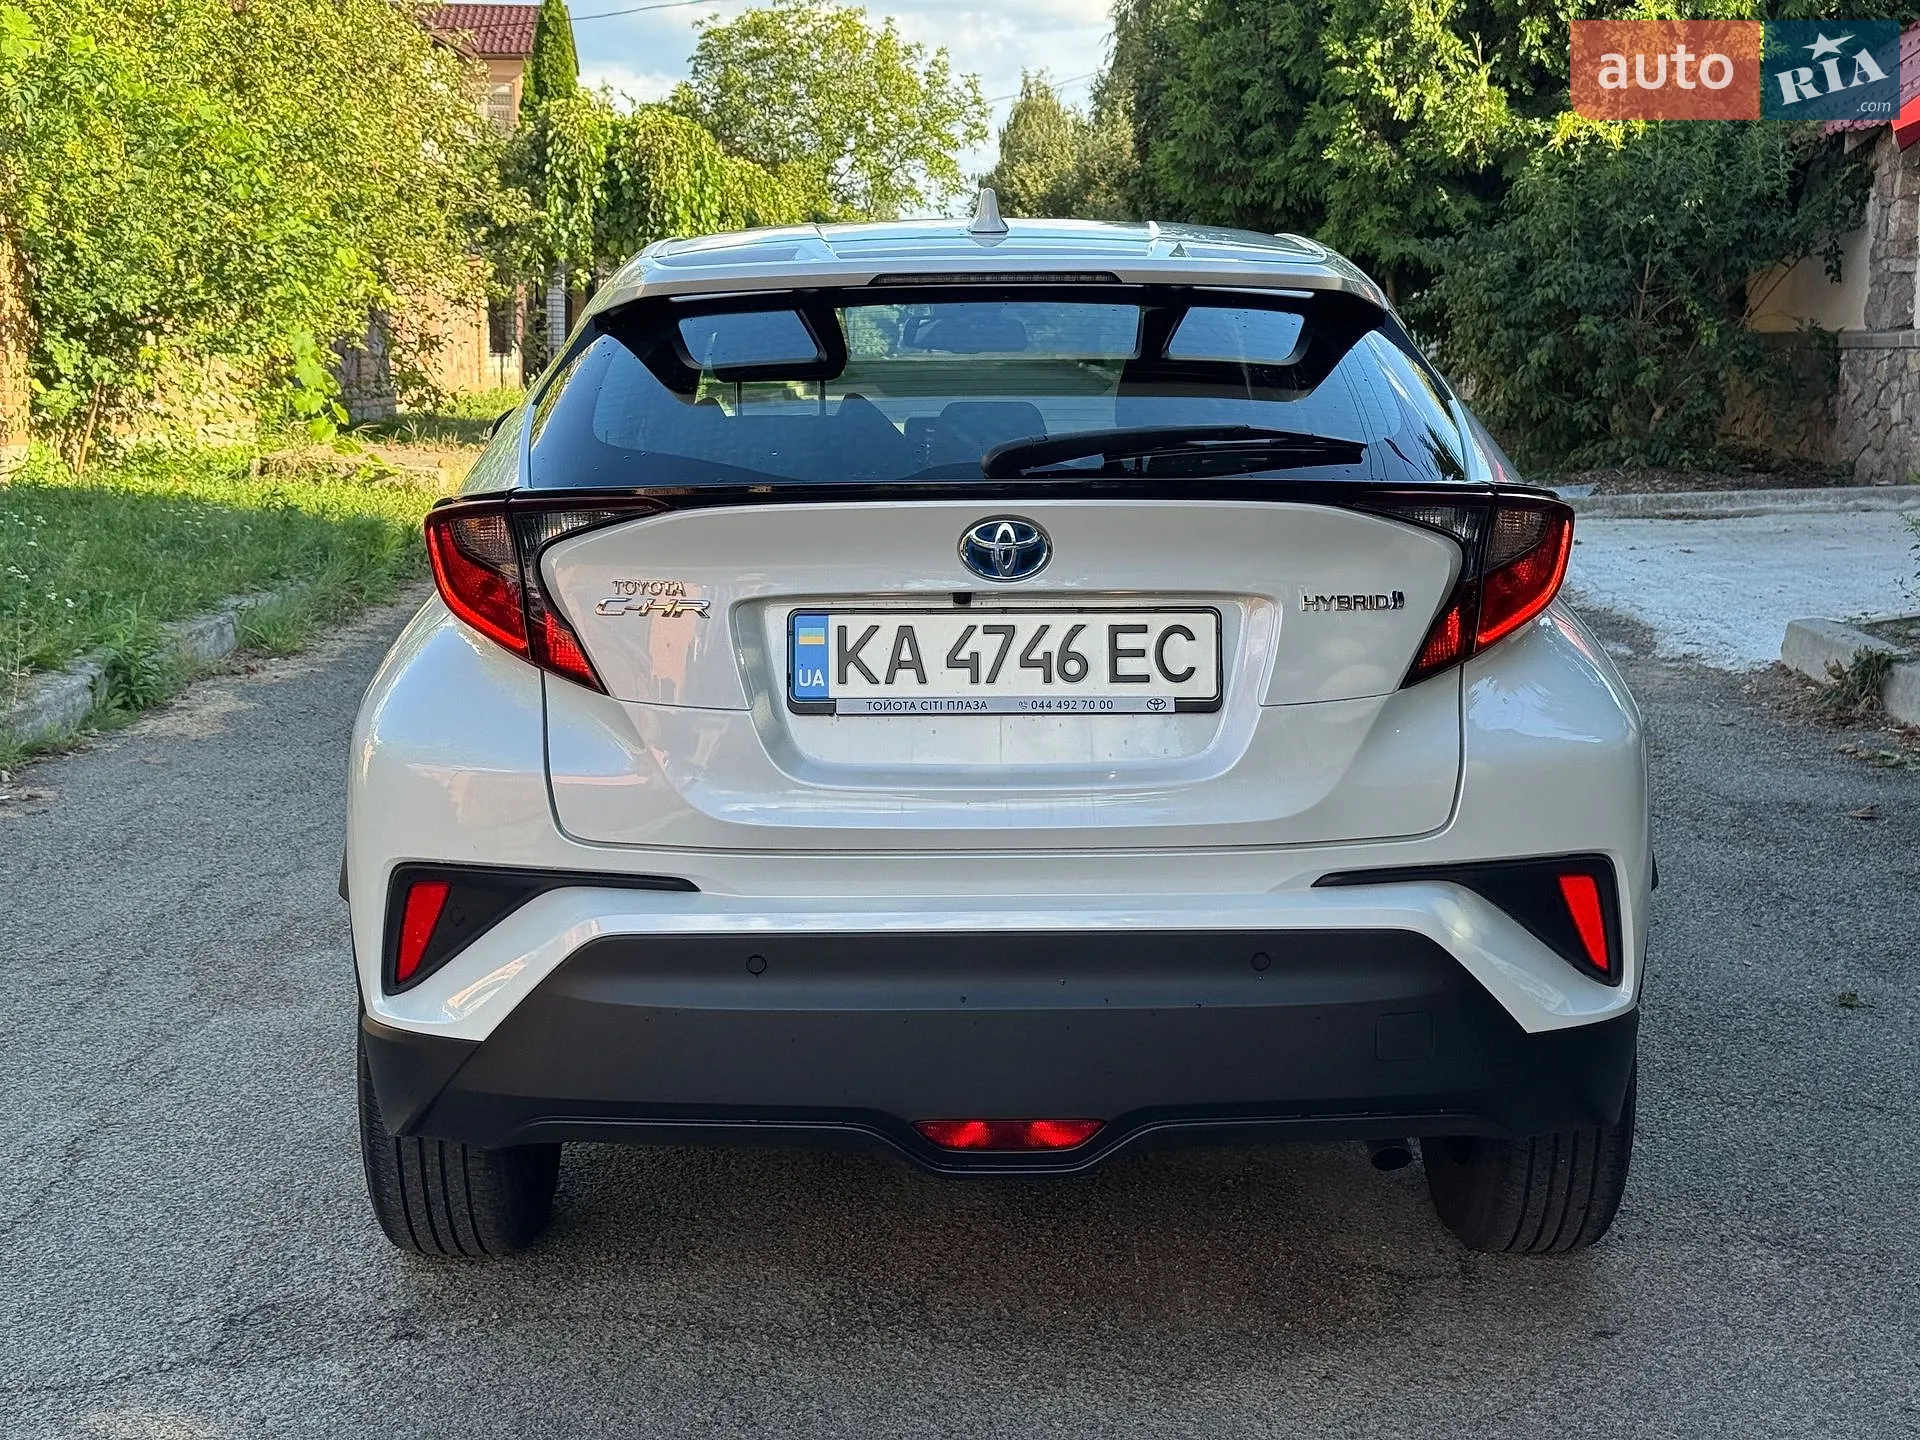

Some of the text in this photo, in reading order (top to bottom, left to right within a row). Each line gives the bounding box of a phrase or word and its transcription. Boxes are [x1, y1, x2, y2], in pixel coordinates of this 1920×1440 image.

[612, 580, 687, 596] TOYOTA
[595, 597, 711, 618] C-HR
[1302, 594, 1389, 611] HYBRID
[837, 624, 1196, 684] KA 4746 EC
[799, 669, 825, 687] UA
[866, 699, 917, 711] ТОЙОТА
[947, 700, 988, 710] ПЛАЗА
[1031, 700, 1052, 710] 044
[1056, 700, 1077, 710] 492
[1082, 700, 1095, 710] 70
[1099, 700, 1114, 710] 00
